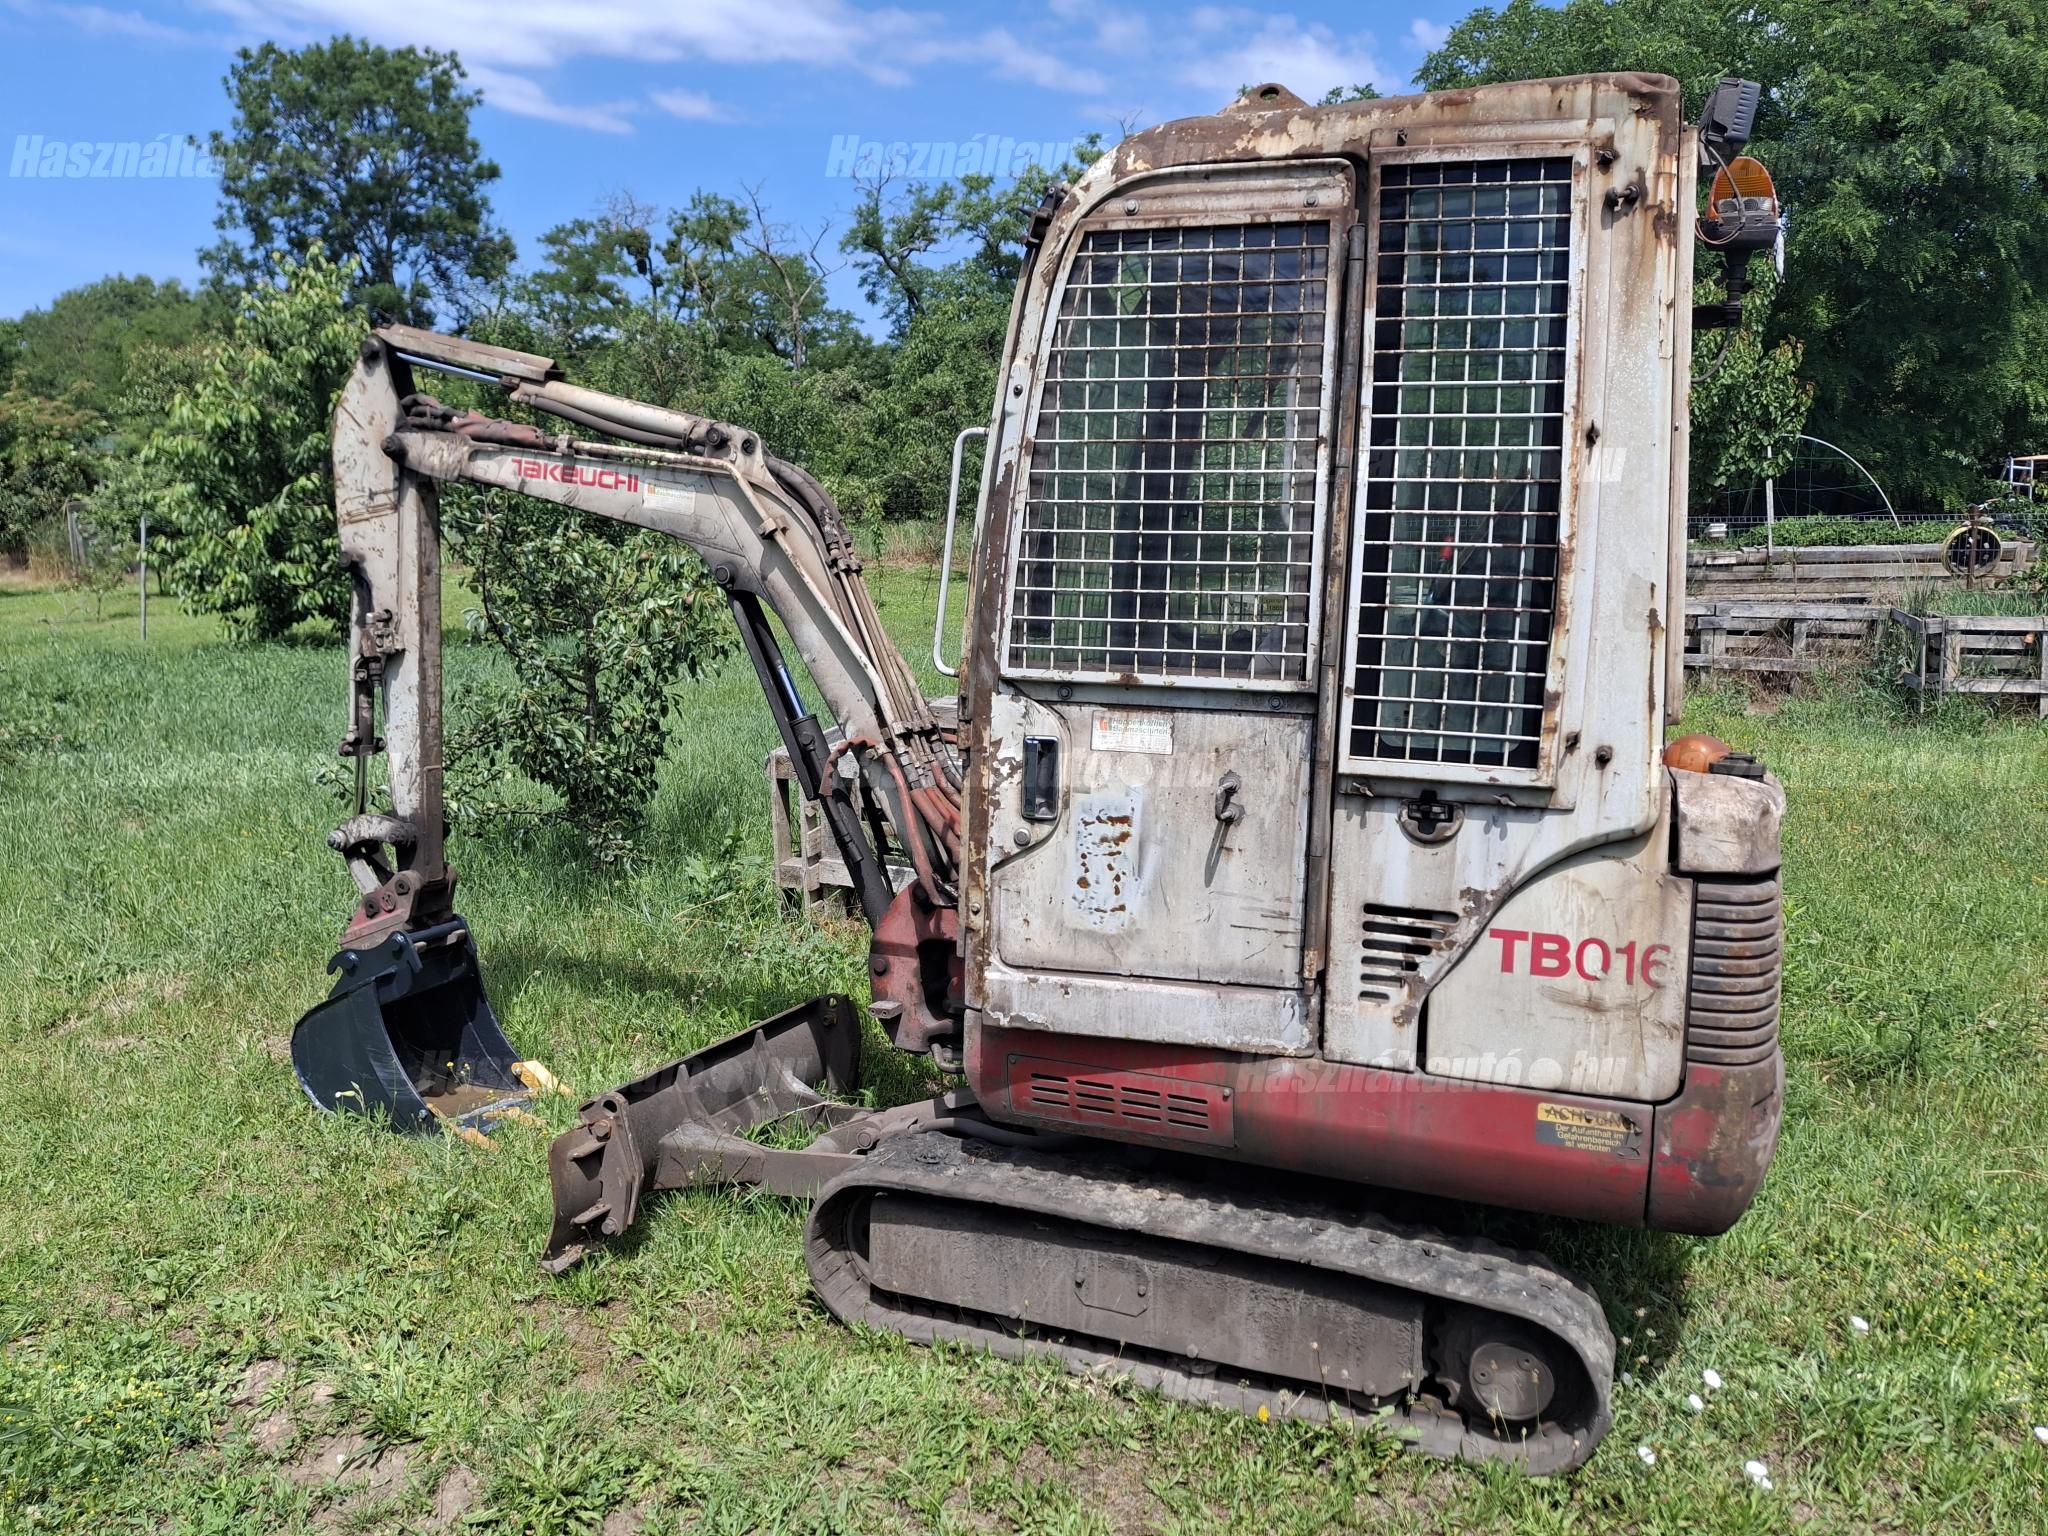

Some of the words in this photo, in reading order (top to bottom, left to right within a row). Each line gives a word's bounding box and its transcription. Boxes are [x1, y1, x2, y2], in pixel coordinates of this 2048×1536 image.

[511, 458, 639, 493] TAKEUCHI
[1489, 928, 1671, 988] TB016
[1556, 1124, 1569, 1132] Der
[1557, 1131, 1621, 1147] Gefahrenbereich
[1577, 1142, 1611, 1153] verboten
